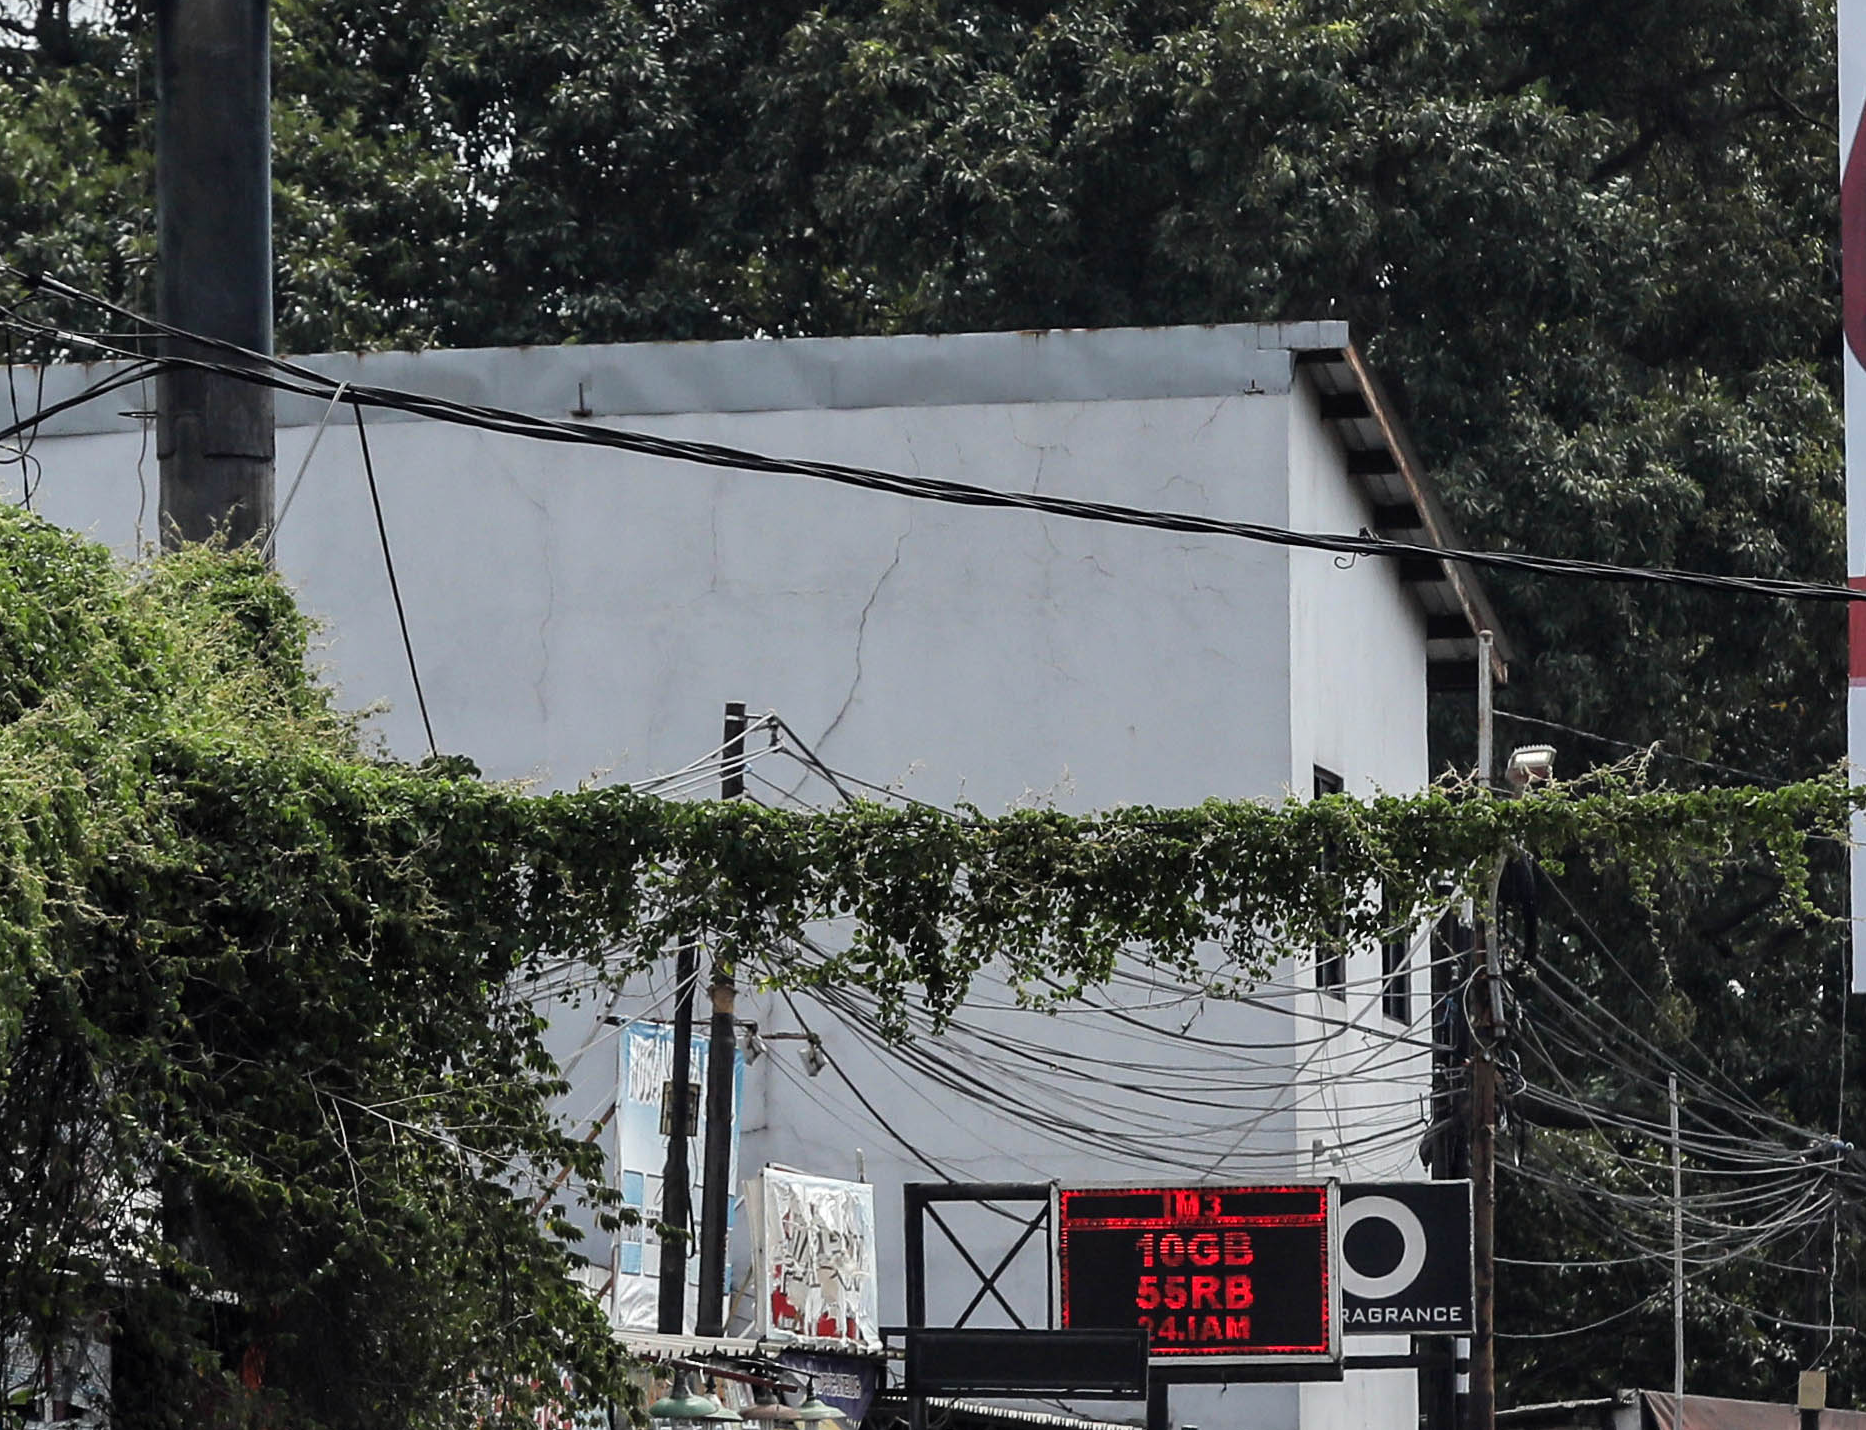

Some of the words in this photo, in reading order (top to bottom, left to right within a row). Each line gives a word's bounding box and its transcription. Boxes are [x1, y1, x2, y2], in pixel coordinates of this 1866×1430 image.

[1136, 1232, 1253, 1267] 10GB
[1136, 1275, 1253, 1310] 55RB
[1341, 1307, 1462, 1324] RAGRANCE
